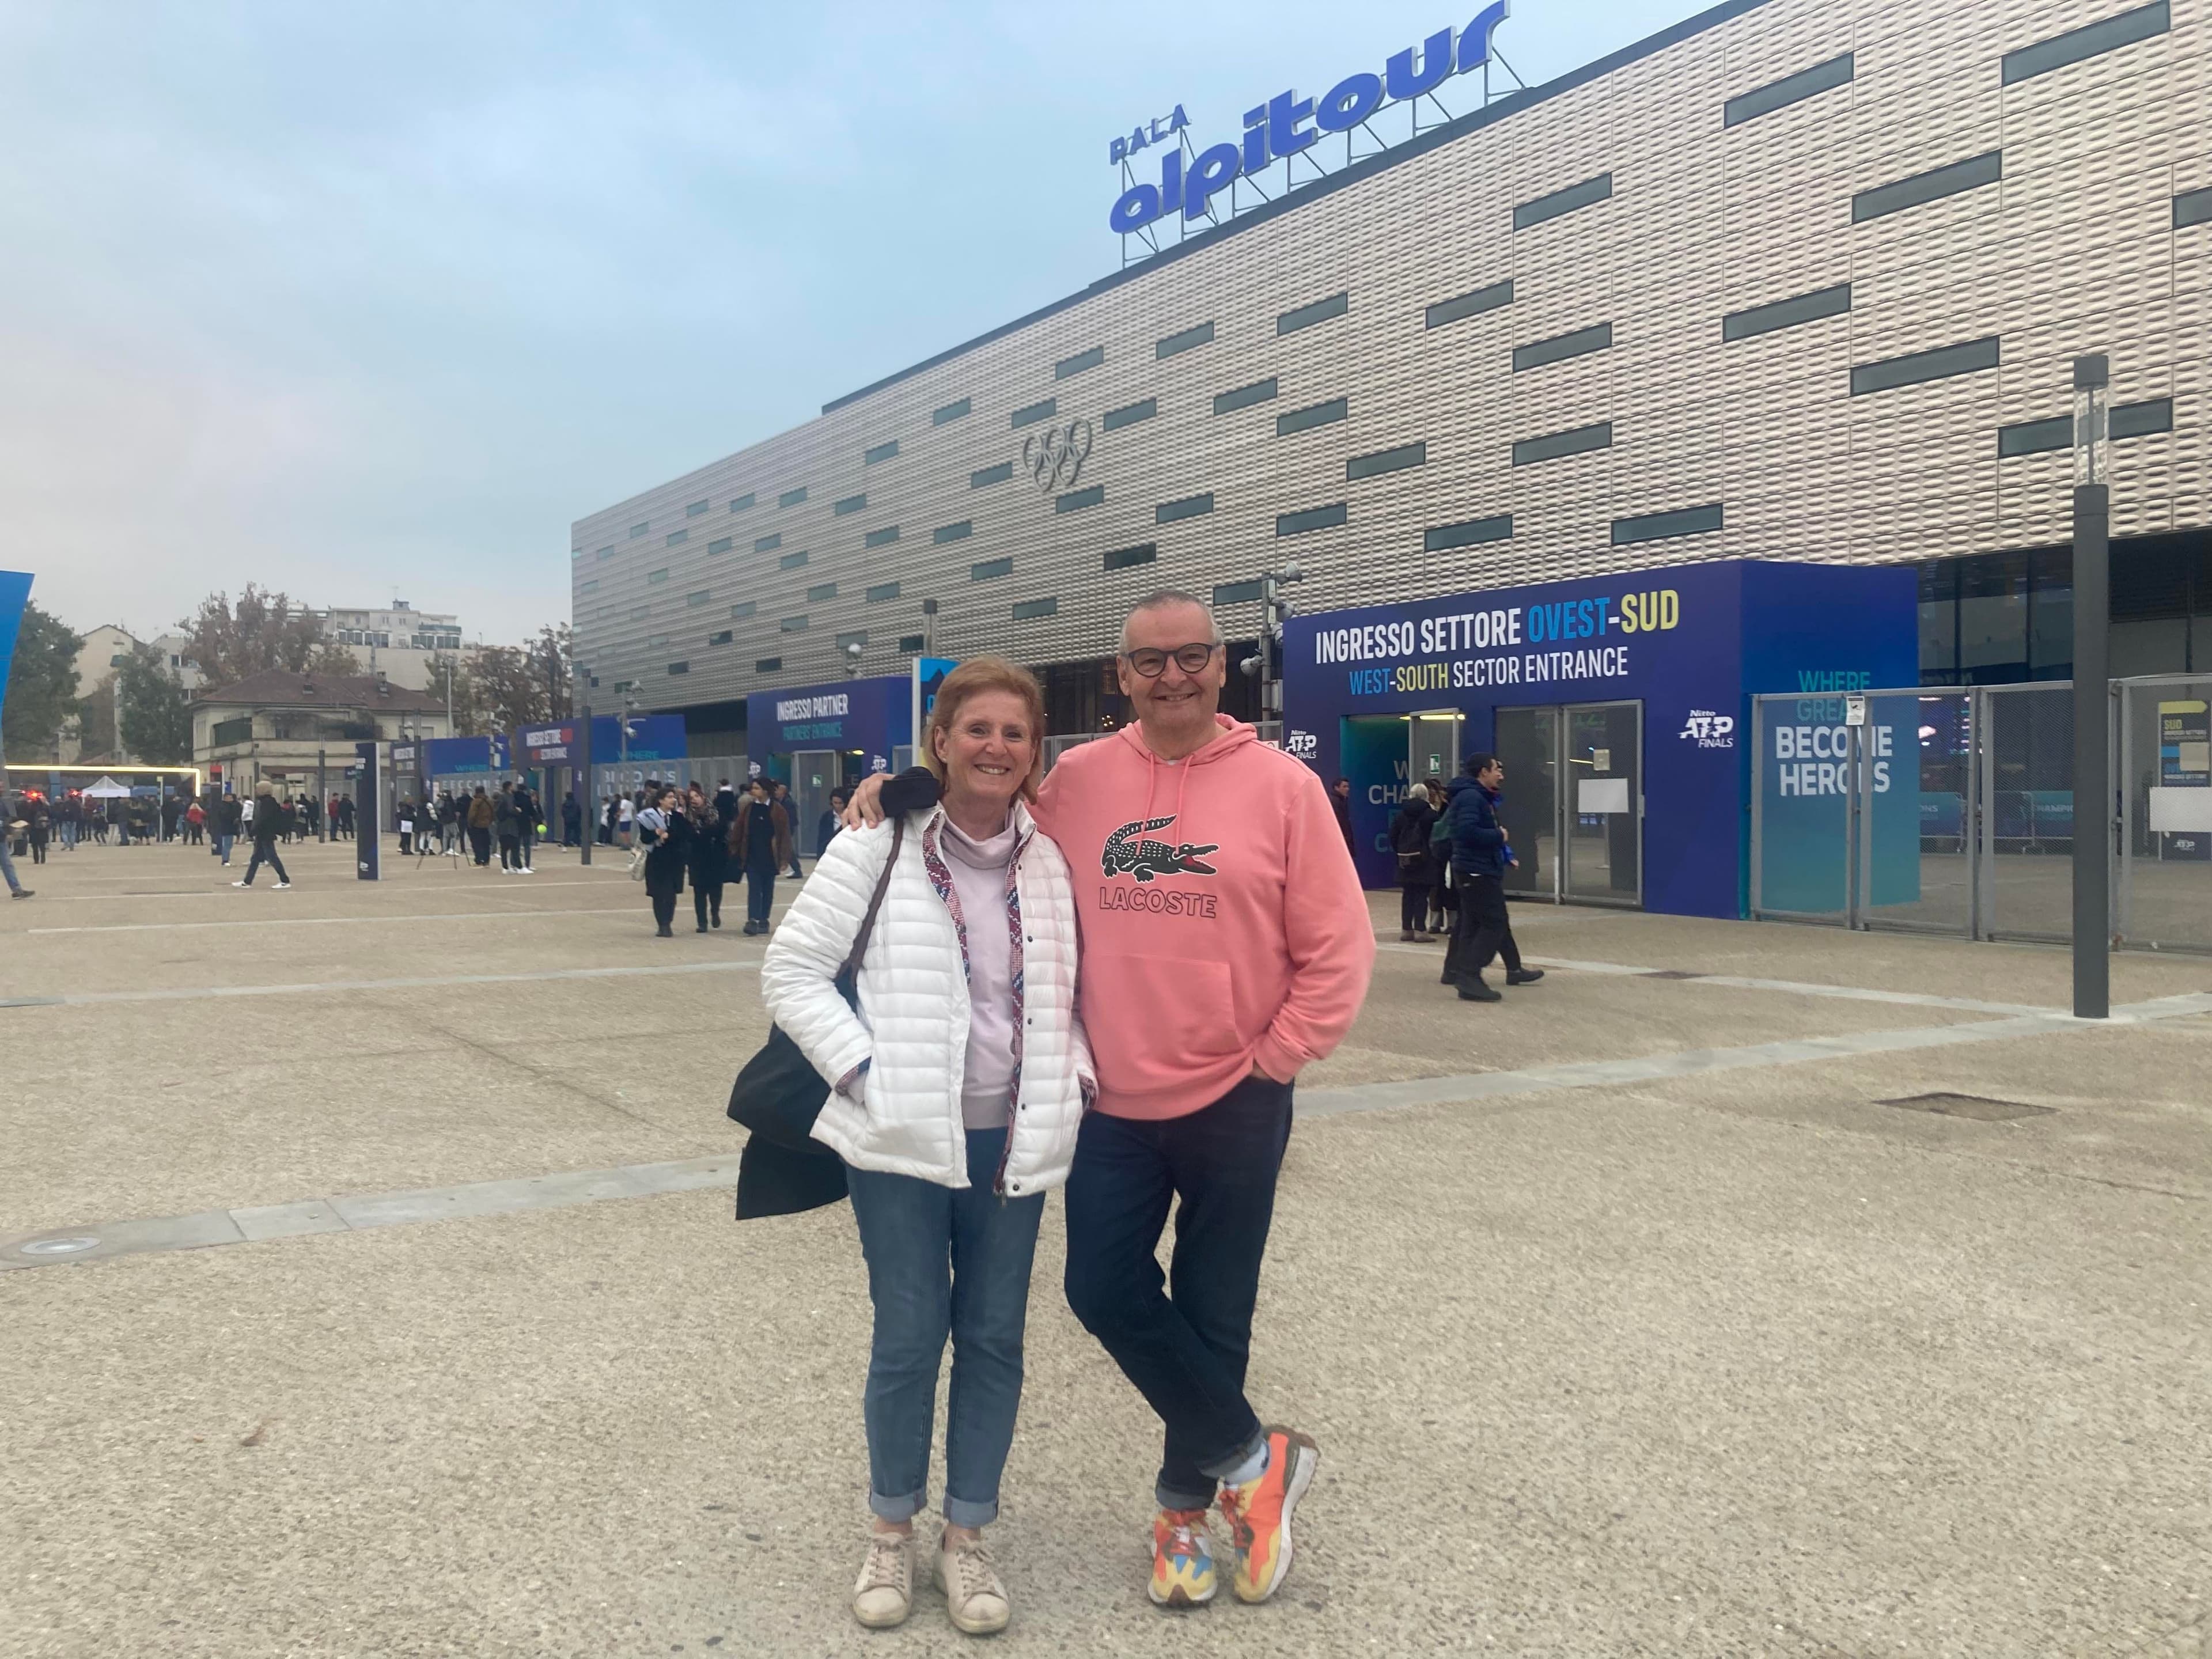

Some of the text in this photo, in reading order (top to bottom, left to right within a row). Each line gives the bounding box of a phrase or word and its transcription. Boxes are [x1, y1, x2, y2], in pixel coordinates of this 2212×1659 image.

[1109, 0, 1510, 234] alpitour
[1109, 104, 1191, 165] PALA
[1316, 589, 1679, 664] INGRESSO SETTORE OVEST-SUD
[1349, 646, 1628, 696] WEST-SOUTH SECTOR ENTRANCE
[1798, 671, 1871, 692] WHERE
[777, 693, 849, 722] INGRESSO PARTNER
[1677, 716, 1733, 738] ATP
[1284, 734, 1317, 752] ATP
[1698, 738, 1733, 748] FINALS
[1099, 887, 1217, 918] LACOSTE
